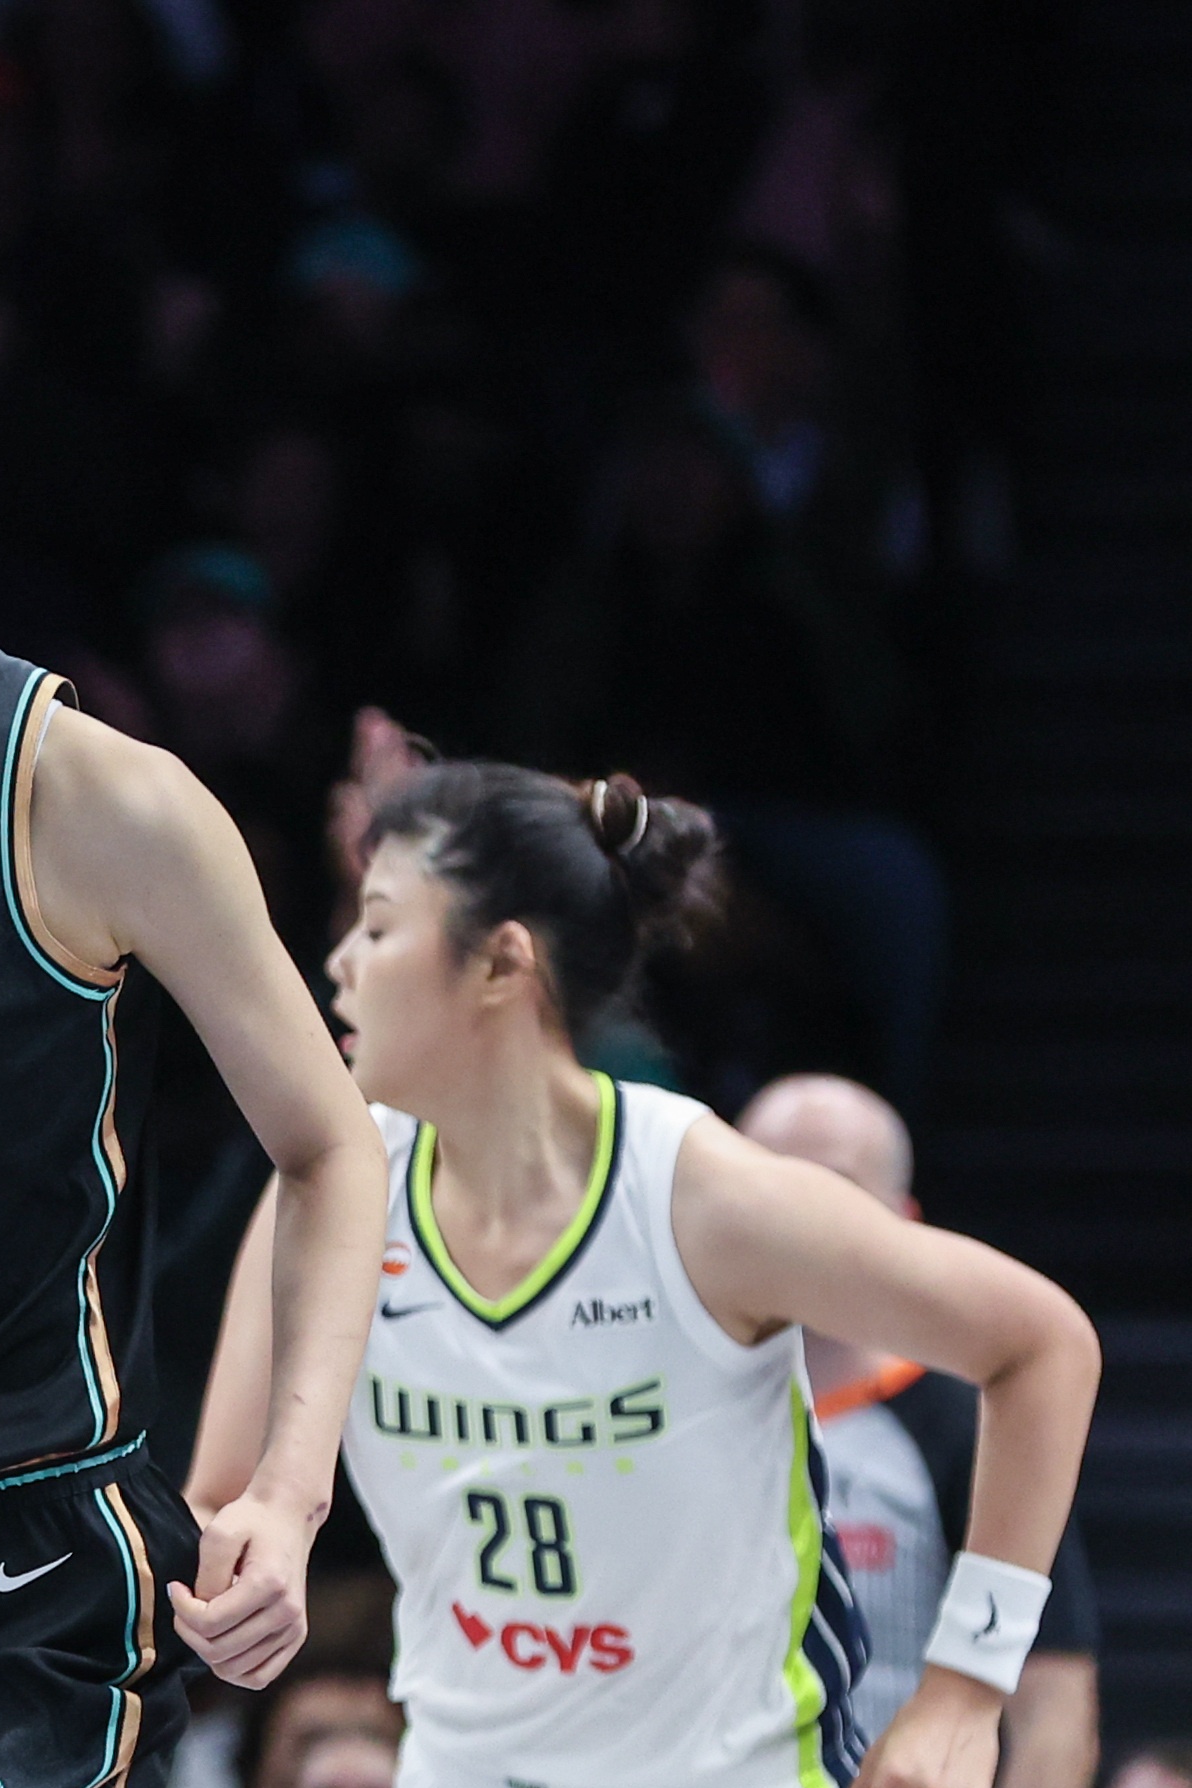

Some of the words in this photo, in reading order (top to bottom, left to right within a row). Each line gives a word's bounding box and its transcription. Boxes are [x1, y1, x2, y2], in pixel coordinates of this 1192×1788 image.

[570, 1298, 655, 1330] Albert
[367, 1372, 667, 1449] WINGS
[464, 1492, 578, 1600] 28
[500, 1622, 636, 1675] CVS
